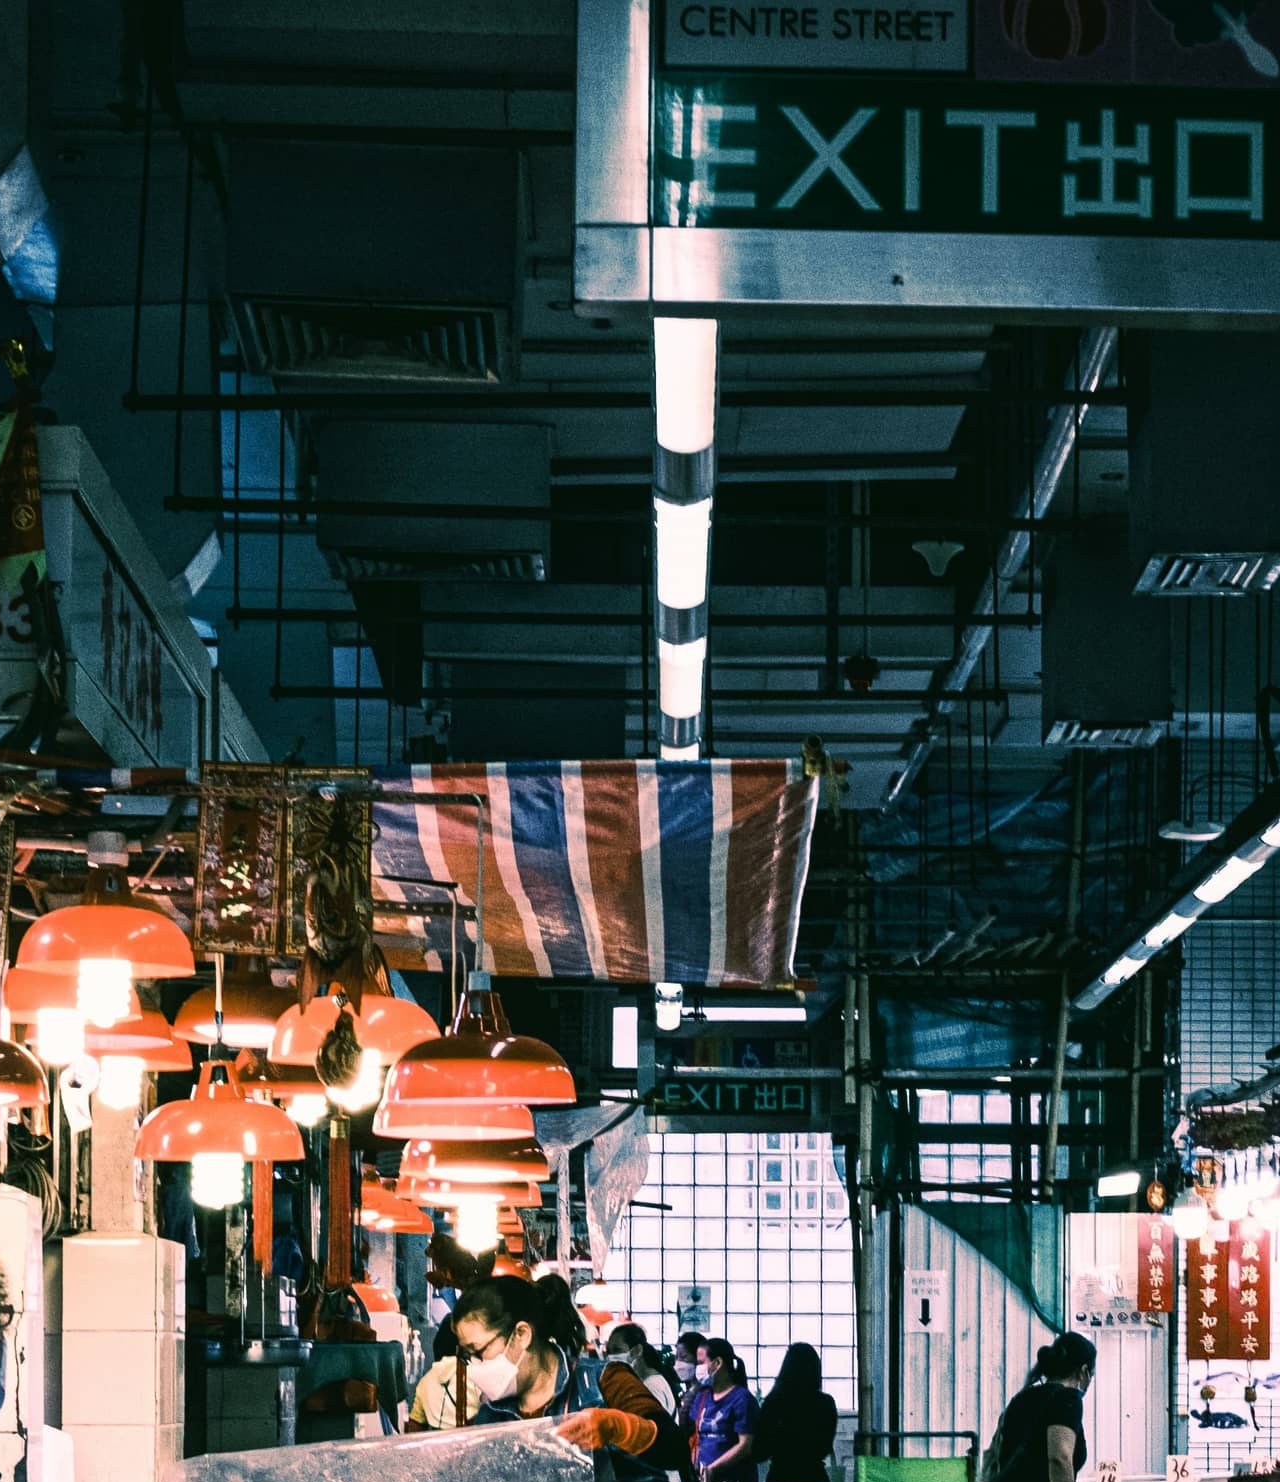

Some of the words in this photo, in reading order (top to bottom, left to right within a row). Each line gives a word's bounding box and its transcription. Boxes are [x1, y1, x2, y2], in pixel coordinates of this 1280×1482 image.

[679, 5, 819, 40] CENTRE
[831, 8, 953, 43] STREET
[692, 103, 1036, 213] EXIT
[1063, 109, 1264, 220] 出口
[664, 1083, 748, 1111] EXIT
[754, 1083, 805, 1112] 出口
[1147, 1221, 1166, 1310] 百無禁忌
